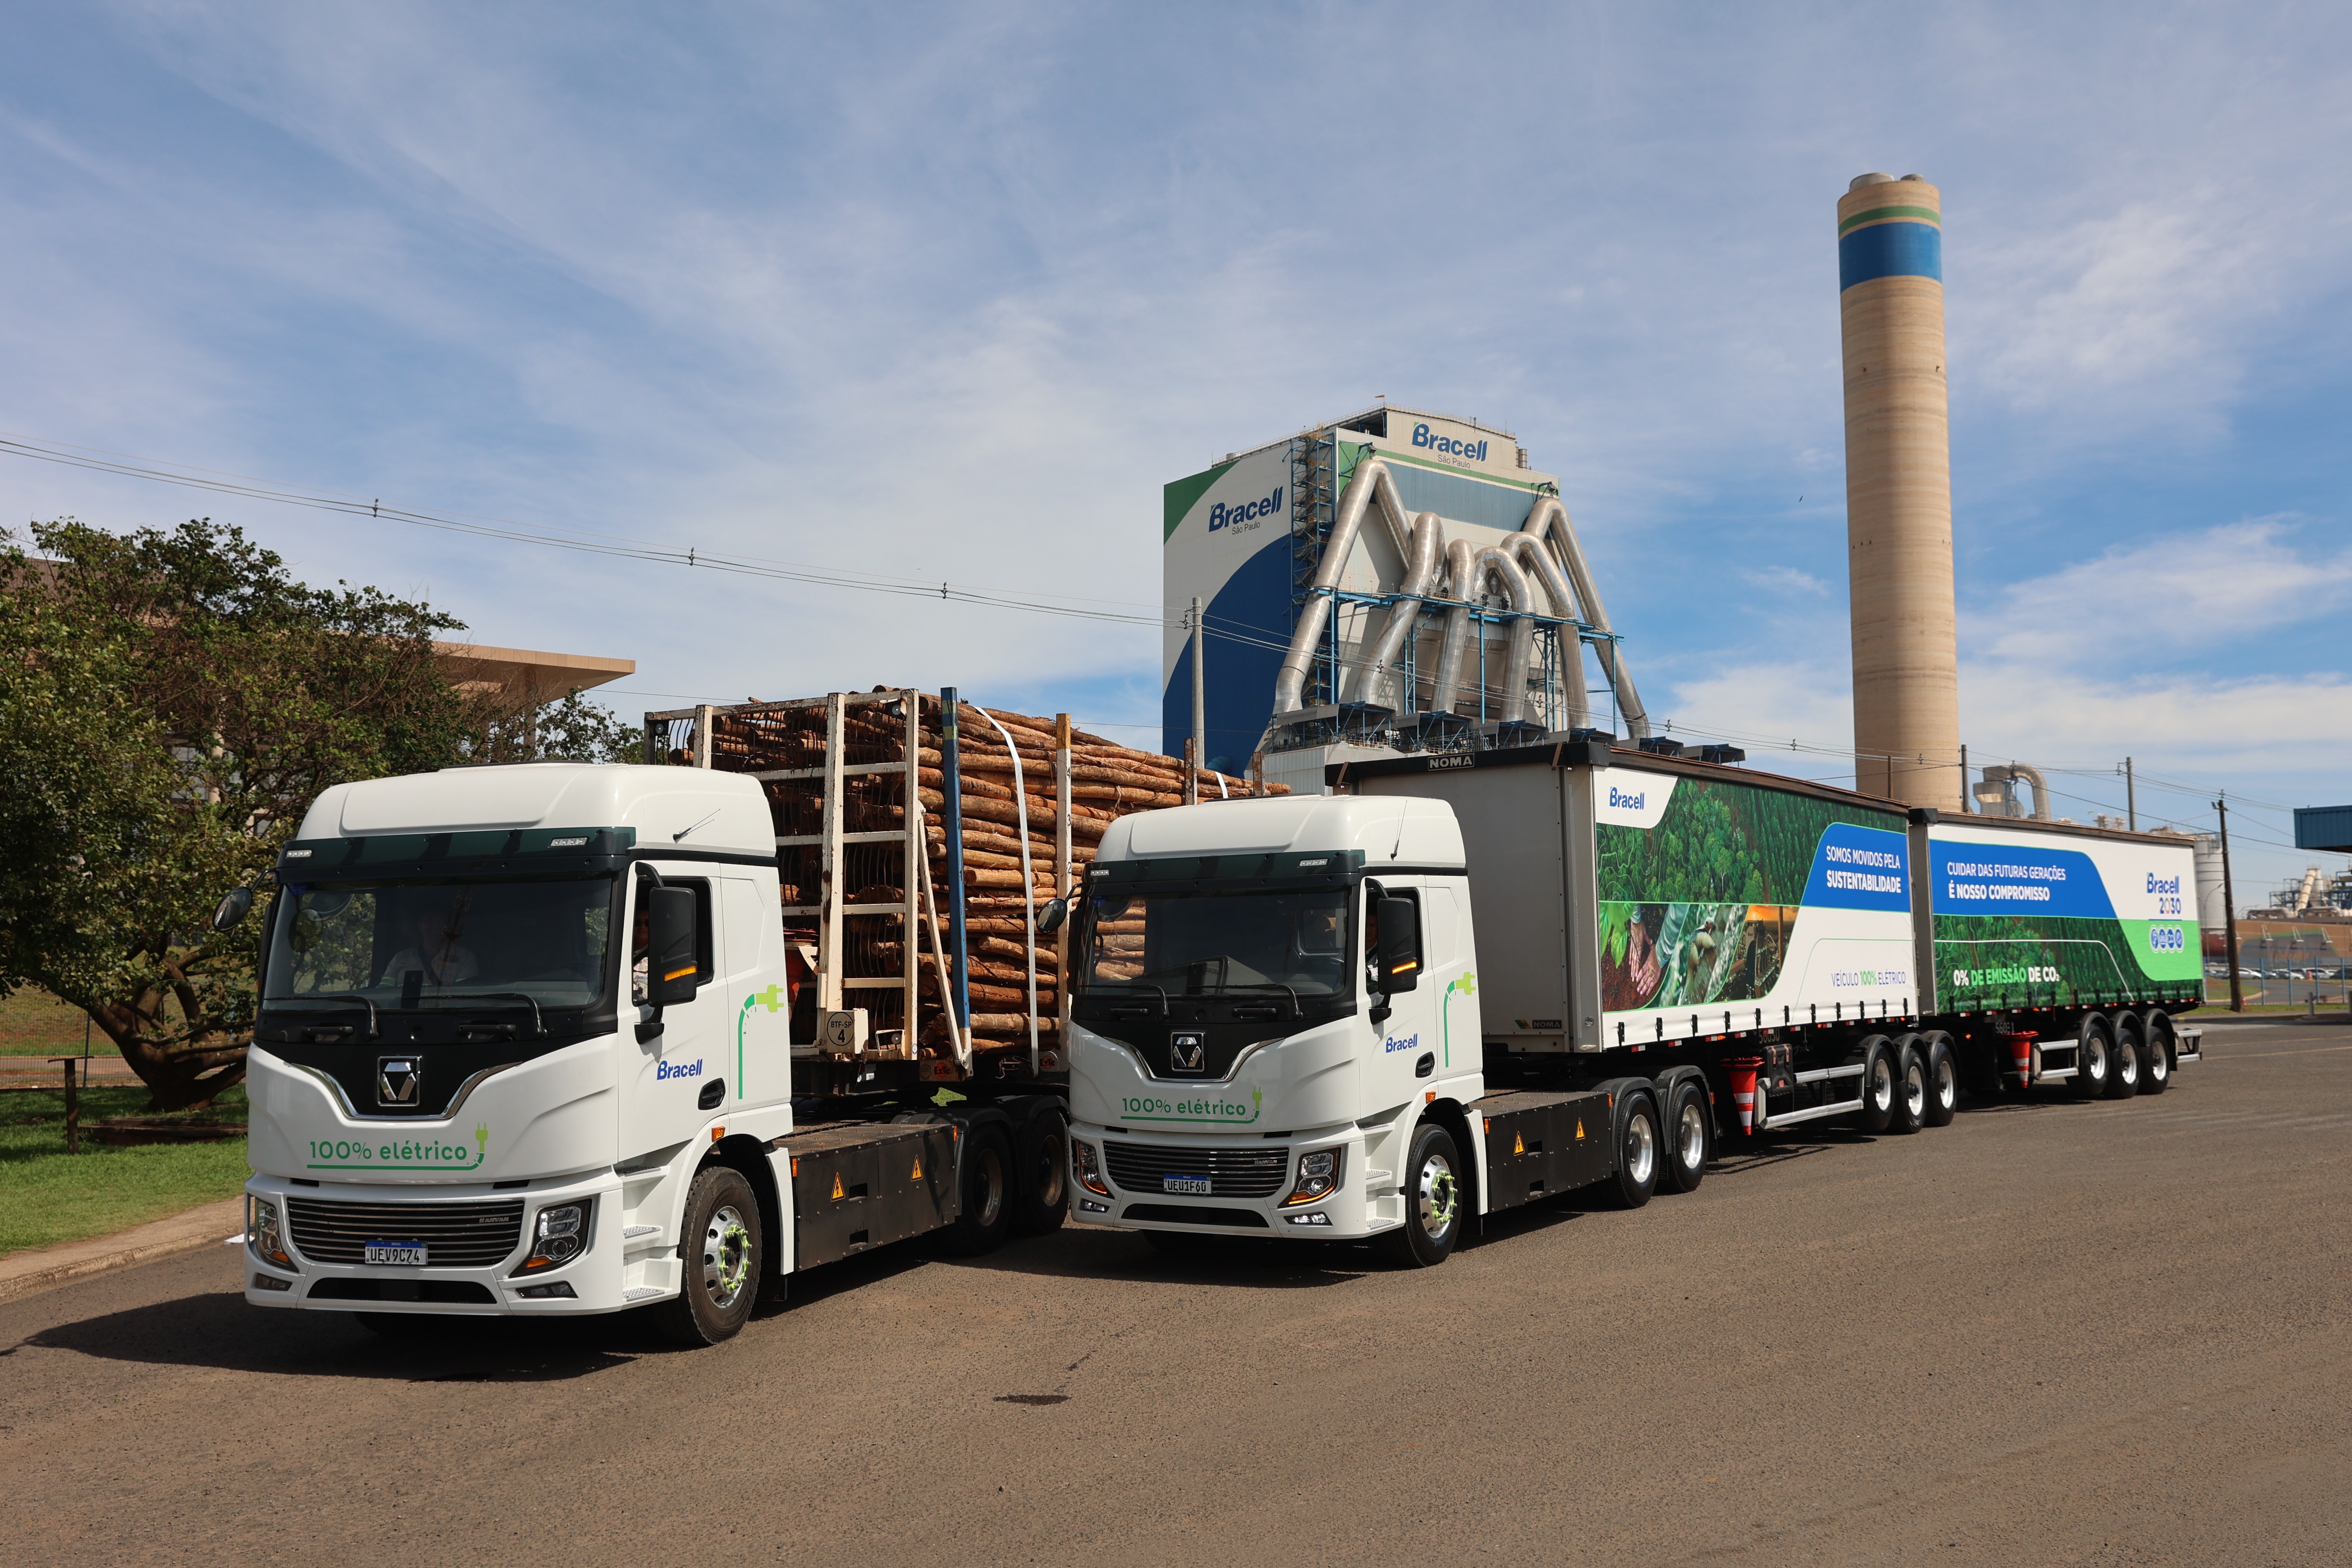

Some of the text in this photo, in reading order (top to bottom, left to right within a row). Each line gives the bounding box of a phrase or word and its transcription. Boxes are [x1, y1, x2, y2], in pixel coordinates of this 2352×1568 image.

[1412, 423, 1488, 462] Bracell
[1438, 454, 1470, 469] São Paulo
[1209, 486, 1283, 532] Bracell
[1232, 521, 1260, 535] São Paulo
[1430, 756, 1472, 768] NOMA
[1610, 787, 1645, 810] Bracell
[1067, 814, 1071, 826] 3
[1826, 845, 1901, 869] SOMOS MOVIDOS PELA
[1067, 862, 1071, 873] 2
[1947, 862, 2066, 882] CUIDAR DAS FUTURAS GERAÇÕES
[1827, 870, 1902, 893] SUSTENTABILIDADE
[1948, 880, 2050, 901] É NOSSO COMPROMISSO
[2147, 872, 2180, 894] Bracell
[2159, 897, 2181, 914] 2030
[1831, 969, 1906, 986] VEÍCULO 100% ELÉTRICO
[1954, 969, 1969, 986] 0%
[1970, 970, 1984, 986] DE
[1985, 963, 2027, 984] EMISSÃO
[2028, 967, 2042, 982] DE
[838, 1029, 845, 1043] 4
[1386, 1033, 1418, 1053] Bracell
[657, 1059, 703, 1080] Bracell
[1122, 1098, 1246, 1115] 100% elétrico
[310, 1140, 467, 1160] 100% elétrico
[1167, 1180, 1206, 1192] UEU1F60
